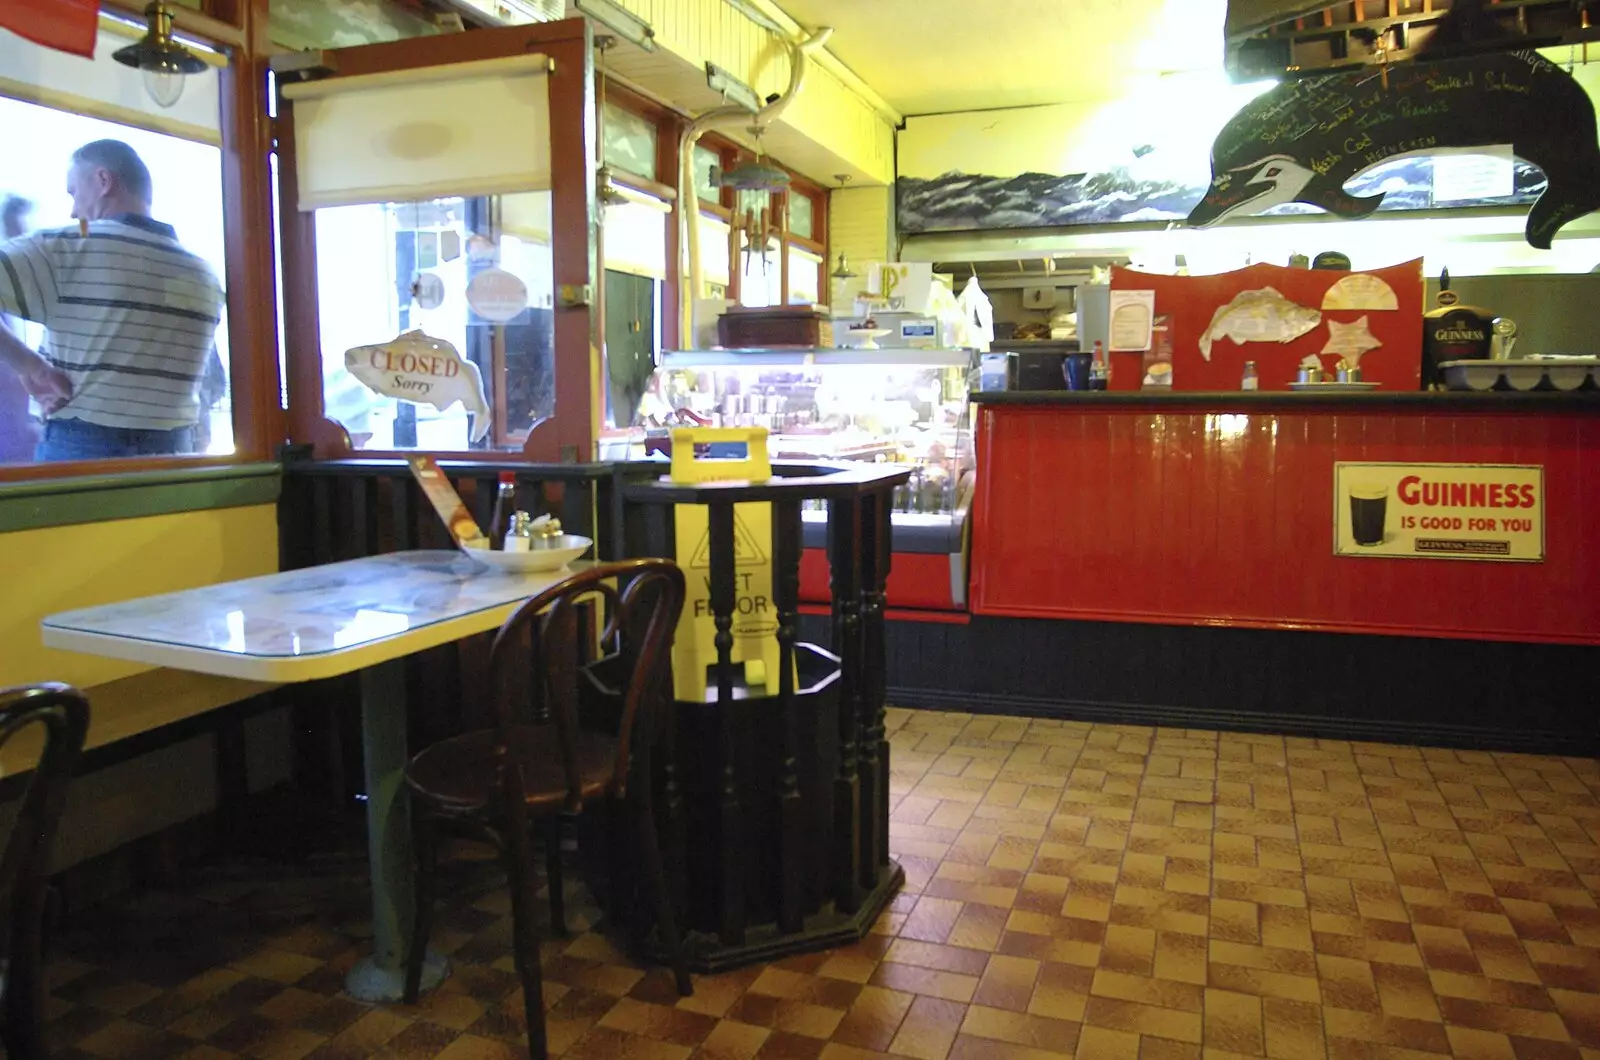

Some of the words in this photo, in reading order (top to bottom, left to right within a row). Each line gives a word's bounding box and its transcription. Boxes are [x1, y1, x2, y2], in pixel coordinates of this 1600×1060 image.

[1344, 132, 1373, 154] Cod
[1434, 329, 1485, 341] GUINNESS
[370, 349, 460, 378] CLOSED
[392, 374, 433, 395] Sorry
[1396, 475, 1536, 509] GUINNESS
[1401, 515, 1416, 530] IS
[1420, 516, 1463, 531] GOOD
[1468, 518, 1497, 532] FOR
[1501, 519, 1532, 533] YOU
